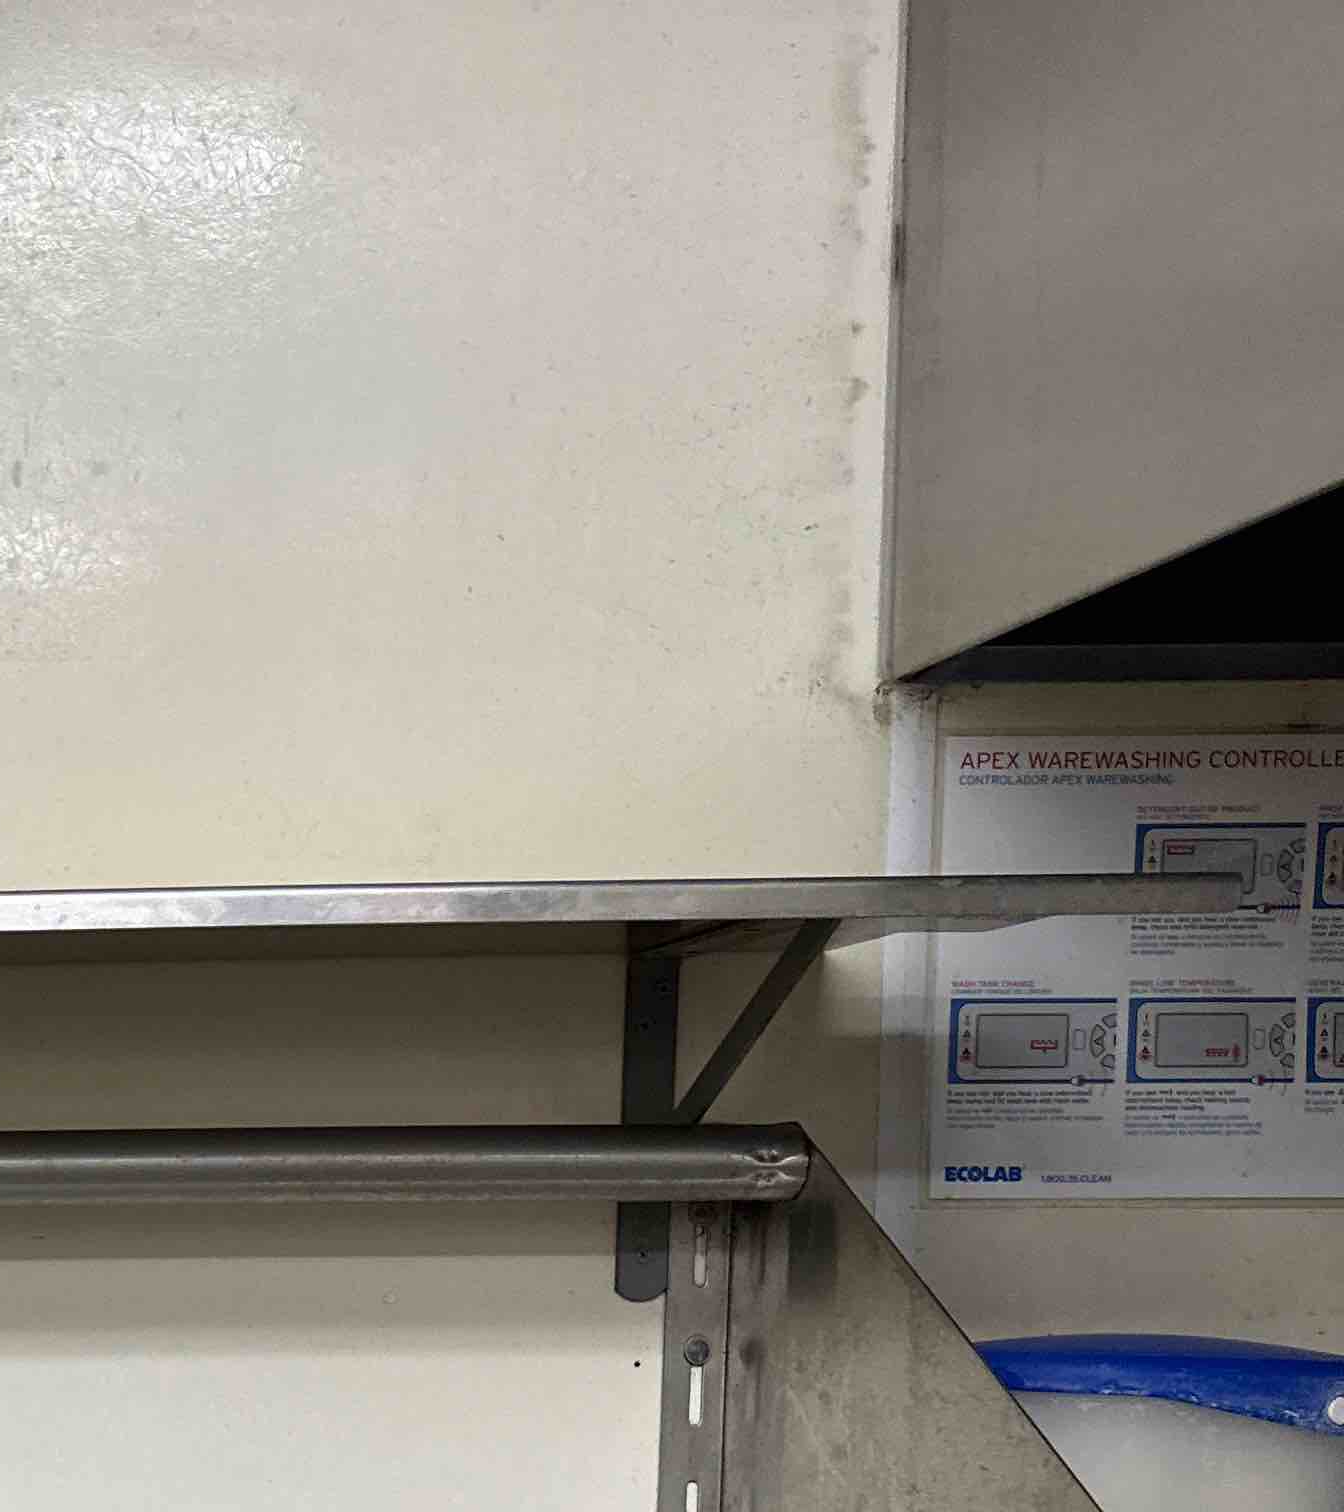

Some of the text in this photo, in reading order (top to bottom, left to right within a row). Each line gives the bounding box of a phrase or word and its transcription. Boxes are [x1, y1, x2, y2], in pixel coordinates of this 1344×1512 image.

[961, 751, 1019, 769] APEX
[1028, 750, 1201, 769] WAREWASHING
[959, 774, 1176, 785] CONTROLADOR APEX WAREWASHING
[944, 1166, 1023, 1182] ECOLAB
